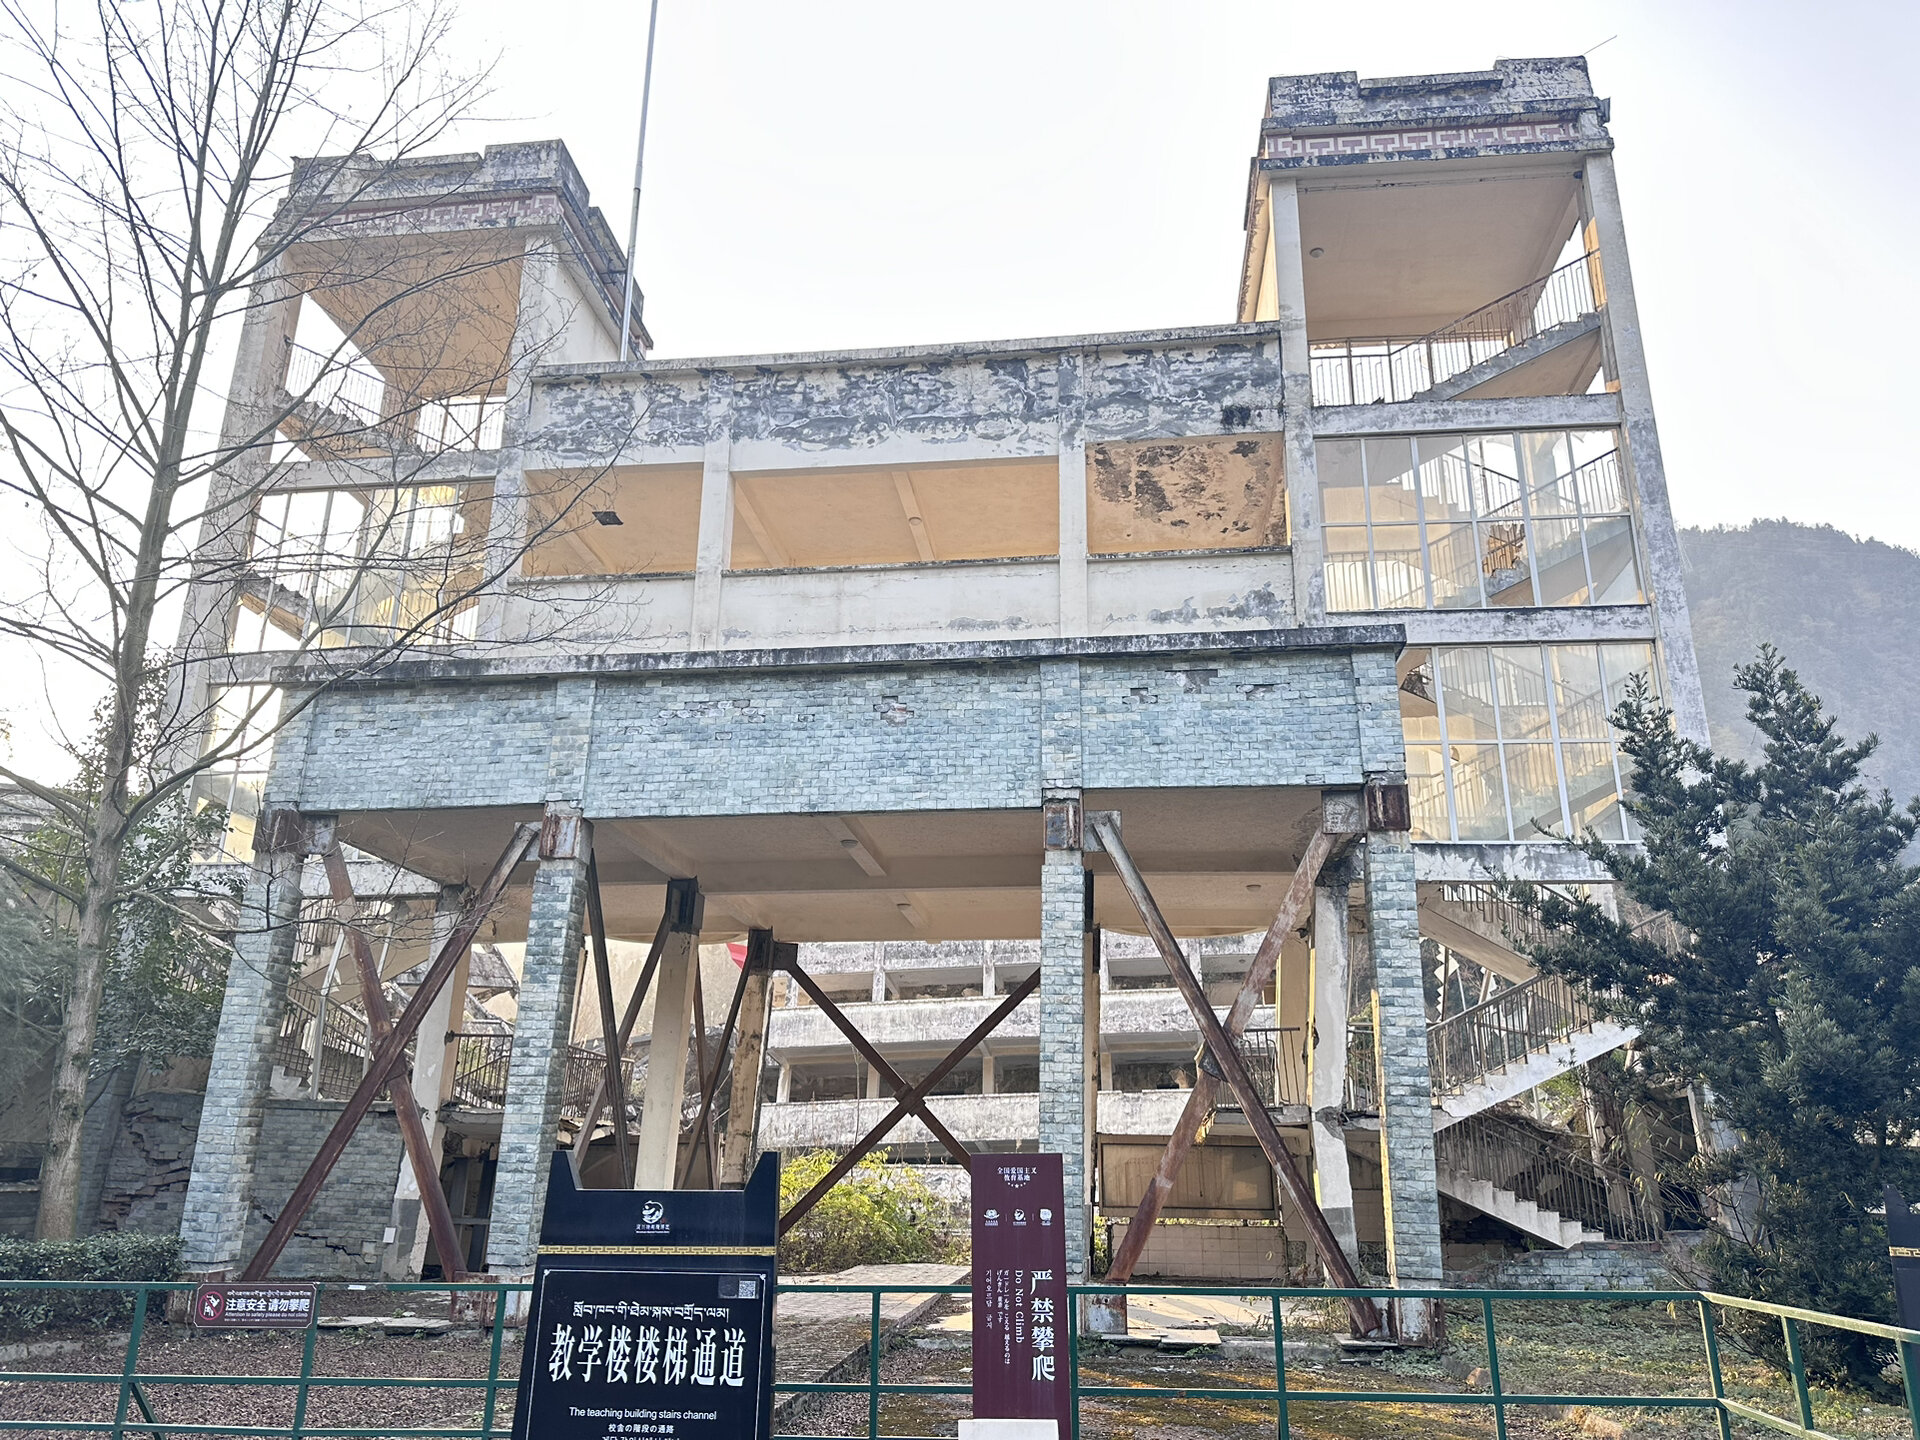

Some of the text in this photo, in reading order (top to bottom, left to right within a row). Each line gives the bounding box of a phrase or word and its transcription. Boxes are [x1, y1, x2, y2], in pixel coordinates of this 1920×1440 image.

[1004, 1174, 1031, 1182] 教育基地
[225, 1298, 310, 1312] 注意安全 请勿攀爬
[1015, 1270, 1025, 1344] Do Not Climb
[1030, 1269, 1056, 1382] 严禁攀爬
[549, 1323, 746, 1387] 教学楼楼梯通道
[568, 1406, 718, 1421] The teaching building stairs channel
